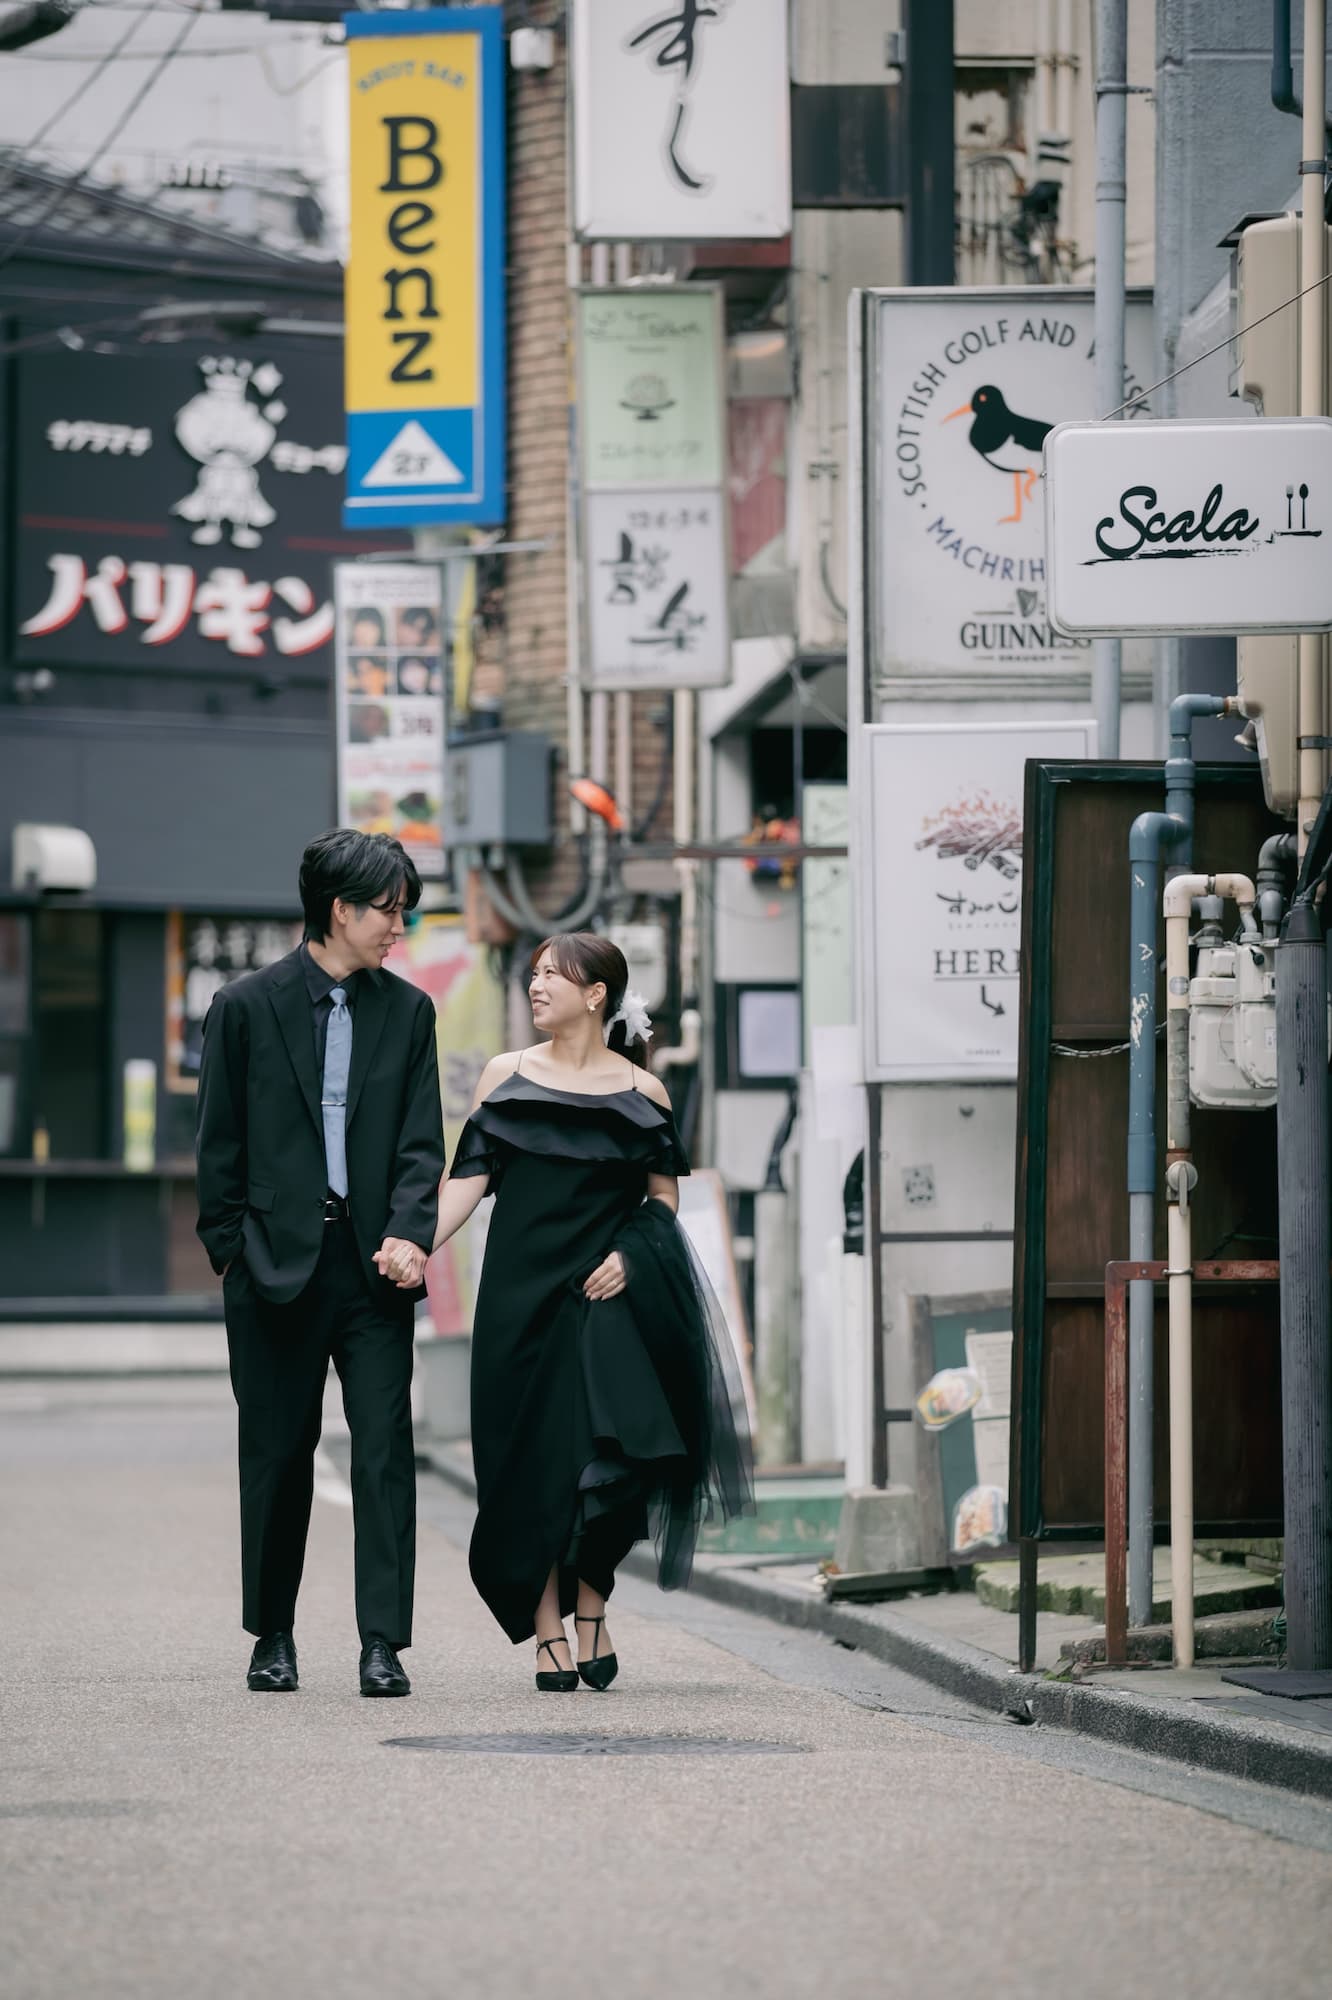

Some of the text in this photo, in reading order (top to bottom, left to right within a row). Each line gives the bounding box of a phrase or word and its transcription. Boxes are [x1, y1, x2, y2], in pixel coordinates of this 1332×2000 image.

[379, 115, 443, 384] Benz
[895, 317, 1077, 498] SCOTTISH GOLF AND
[926, 515, 1046, 582] MACHRIH
[1095, 484, 1259, 559] Scala
[18, 552, 336, 657] パリキン
